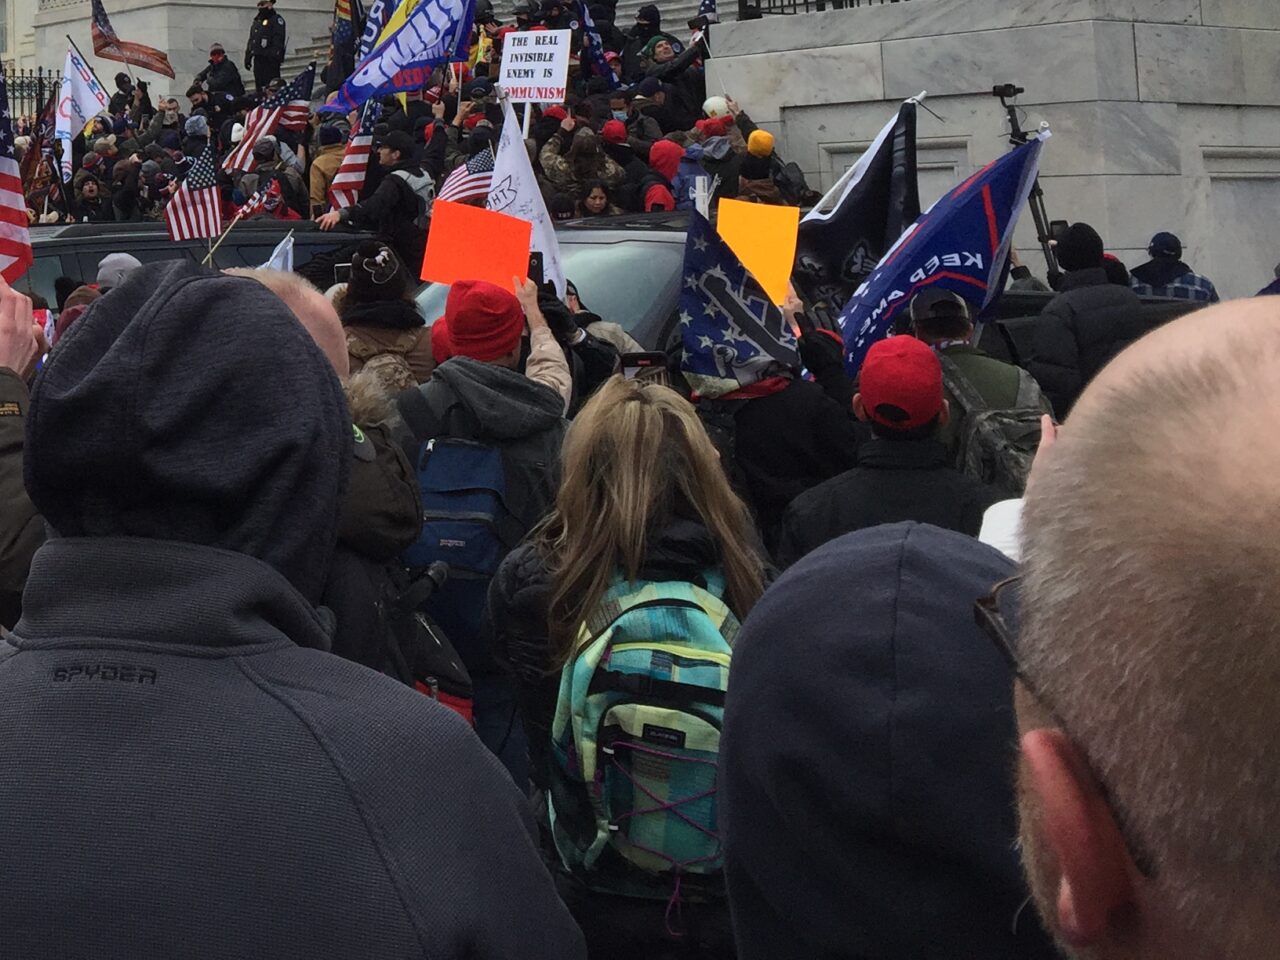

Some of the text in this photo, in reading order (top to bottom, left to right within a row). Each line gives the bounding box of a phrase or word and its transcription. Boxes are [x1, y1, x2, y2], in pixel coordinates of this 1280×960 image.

[512, 36, 558, 46] THE REAL
[510, 52, 554, 63] INVISIBLE
[507, 68, 553, 78] ENEMY IS
[505, 87, 566, 99] OMMUNISM
[53, 665, 157, 684] SPYDER
